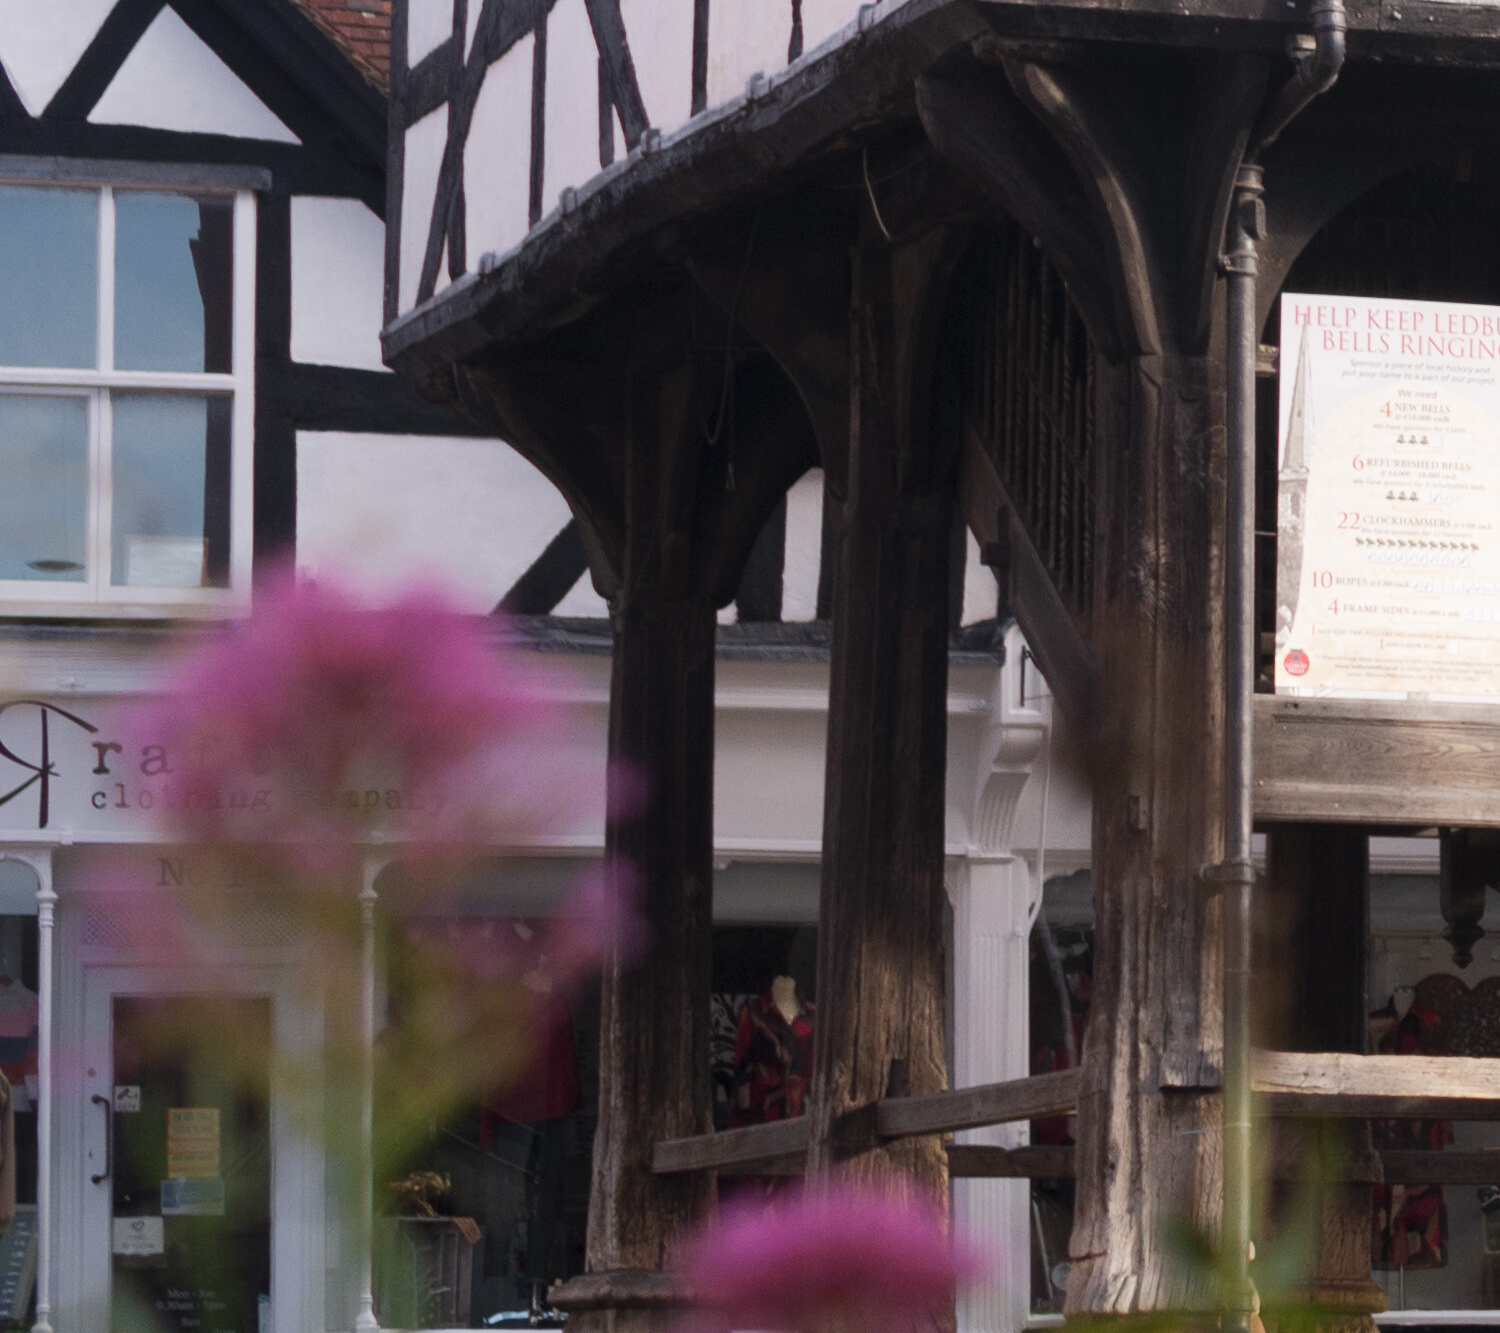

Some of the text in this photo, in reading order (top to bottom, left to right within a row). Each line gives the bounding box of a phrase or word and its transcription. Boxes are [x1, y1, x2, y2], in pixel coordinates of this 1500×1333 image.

[1294, 304, 1356, 327] HELP
[1368, 309, 1424, 332] KEEP
[1323, 329, 1389, 353] BELLS
[1342, 370, 1357, 378] put
[1422, 374, 1439, 382] part
[1391, 362, 1412, 370] piece
[1415, 362, 1424, 370] of
[1446, 364, 1472, 374] history
[1475, 366, 1491, 374] and
[1397, 388, 1438, 399] We need
[1380, 401, 1451, 418] 4 NEW BELLS
[1352, 454, 1364, 471] 6
[1441, 462, 1472, 471] BELLS
[1337, 511, 1361, 530] 22
[1312, 571, 1333, 589] 10
[1336, 576, 1369, 587] ROPES
[1328, 598, 1410, 615] 4 FRAME SIDES
